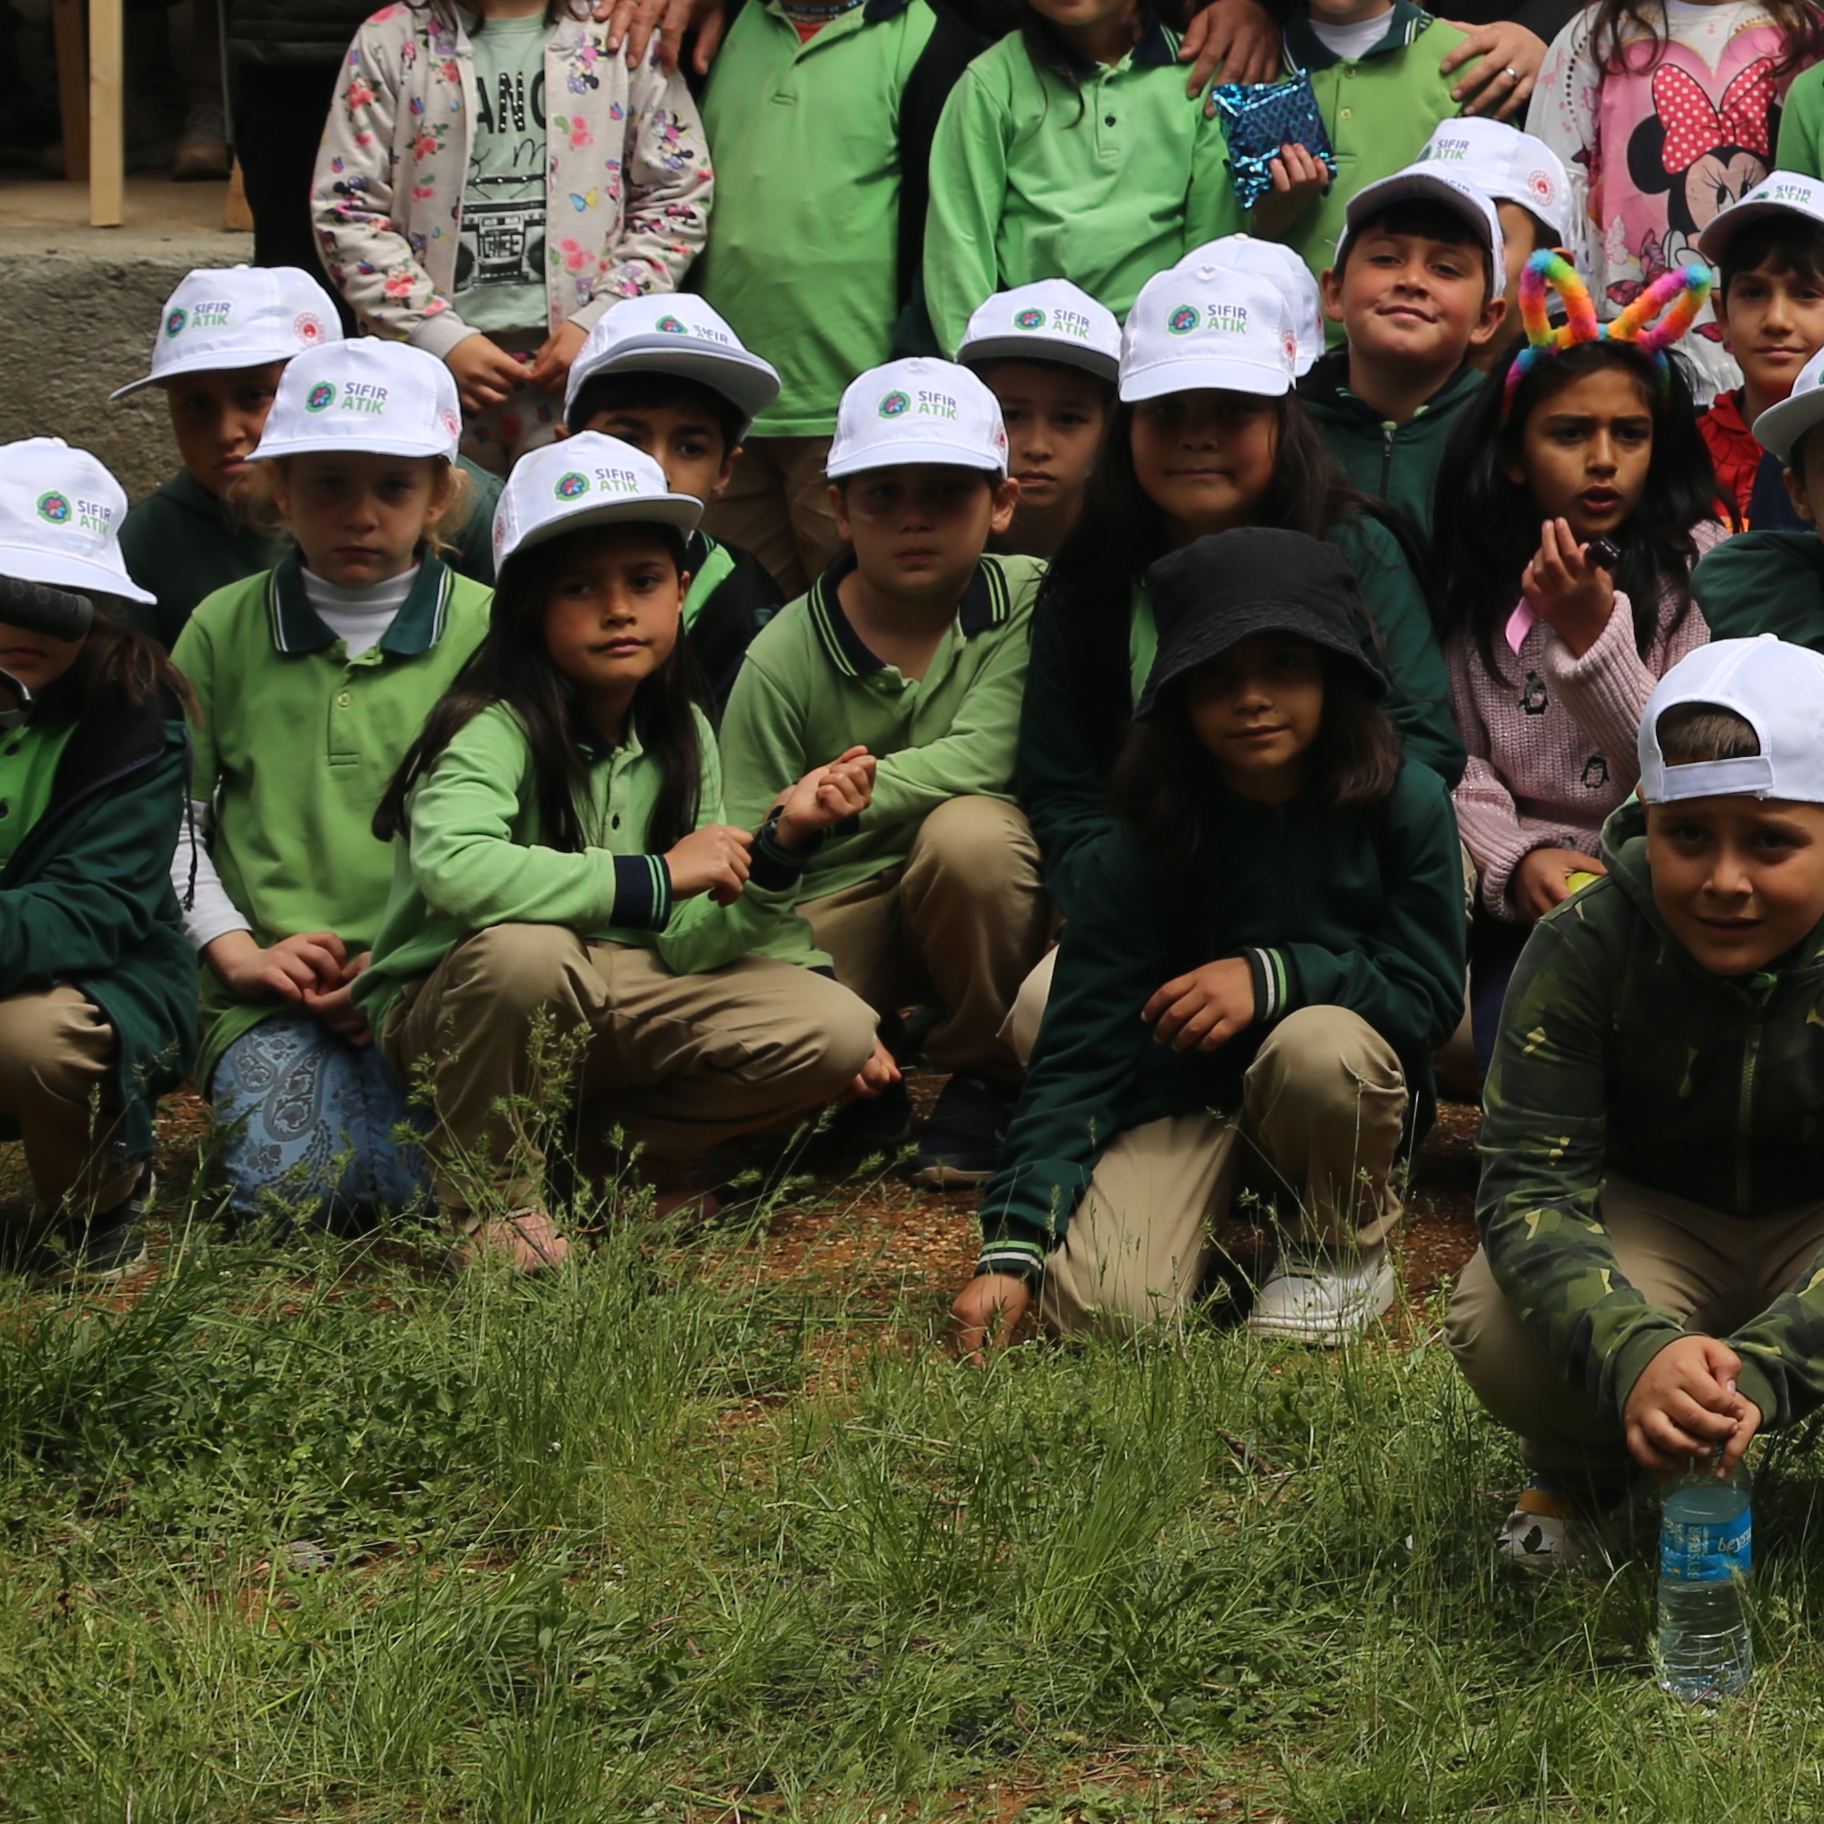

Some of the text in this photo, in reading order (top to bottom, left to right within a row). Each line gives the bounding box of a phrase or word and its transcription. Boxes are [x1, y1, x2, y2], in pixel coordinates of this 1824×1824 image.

[1437, 139, 1470, 150] SIFIR
[1435, 148, 1465, 160] ATIK
[194, 302, 231, 314] SIFIR
[1208, 304, 1248, 320] SIFIR
[192, 313, 228, 327] ATIK
[1054, 309, 1090, 328] SIFIR
[1208, 317, 1246, 334] ATIK
[1053, 320, 1089, 340] ATIK
[345, 382, 388, 401] SIFIR
[919, 390, 957, 407] SIFIR
[341, 396, 383, 414] ATIK
[918, 402, 956, 420] ATIK
[595, 468, 636, 482] SIFIR
[601, 479, 640, 492] ATIK
